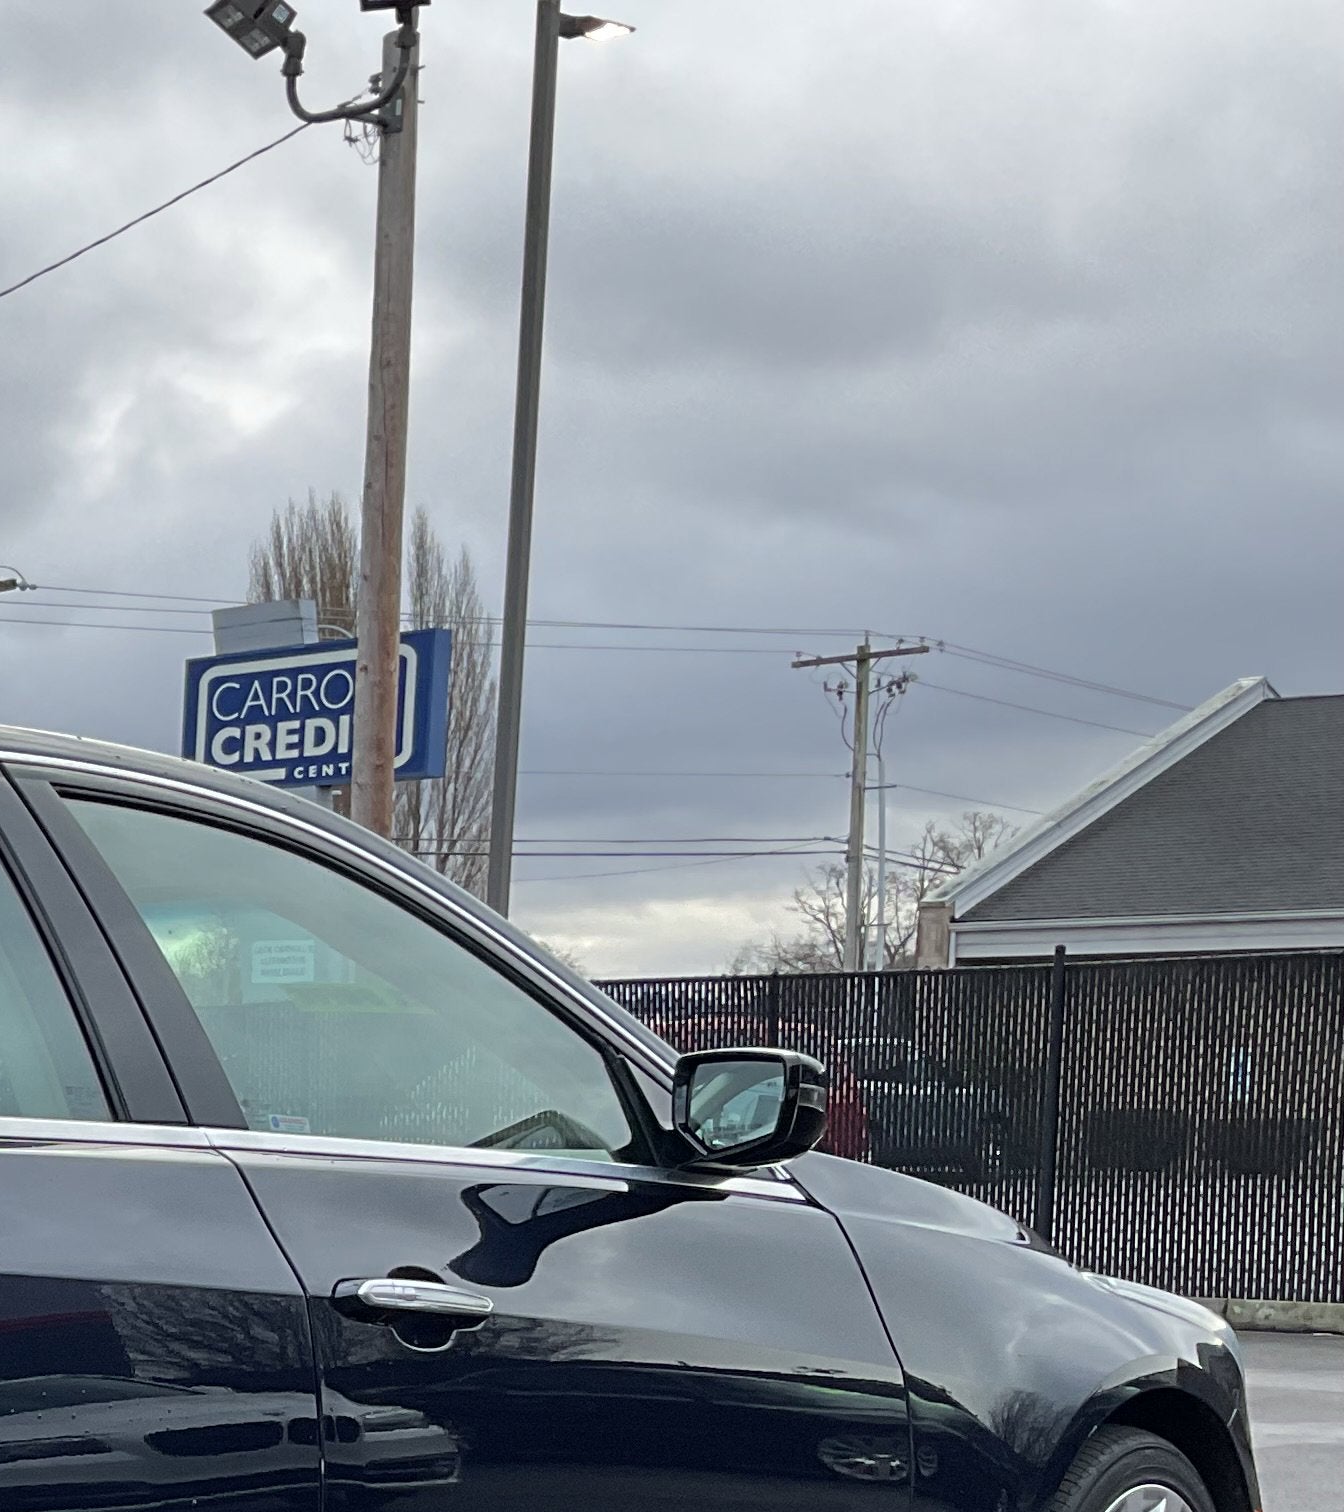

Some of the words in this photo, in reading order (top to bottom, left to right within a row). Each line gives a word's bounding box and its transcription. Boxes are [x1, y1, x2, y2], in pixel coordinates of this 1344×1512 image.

[213, 669, 354, 720] CARRO
[212, 716, 351, 765] CREDI
[294, 762, 350, 779] CENT
